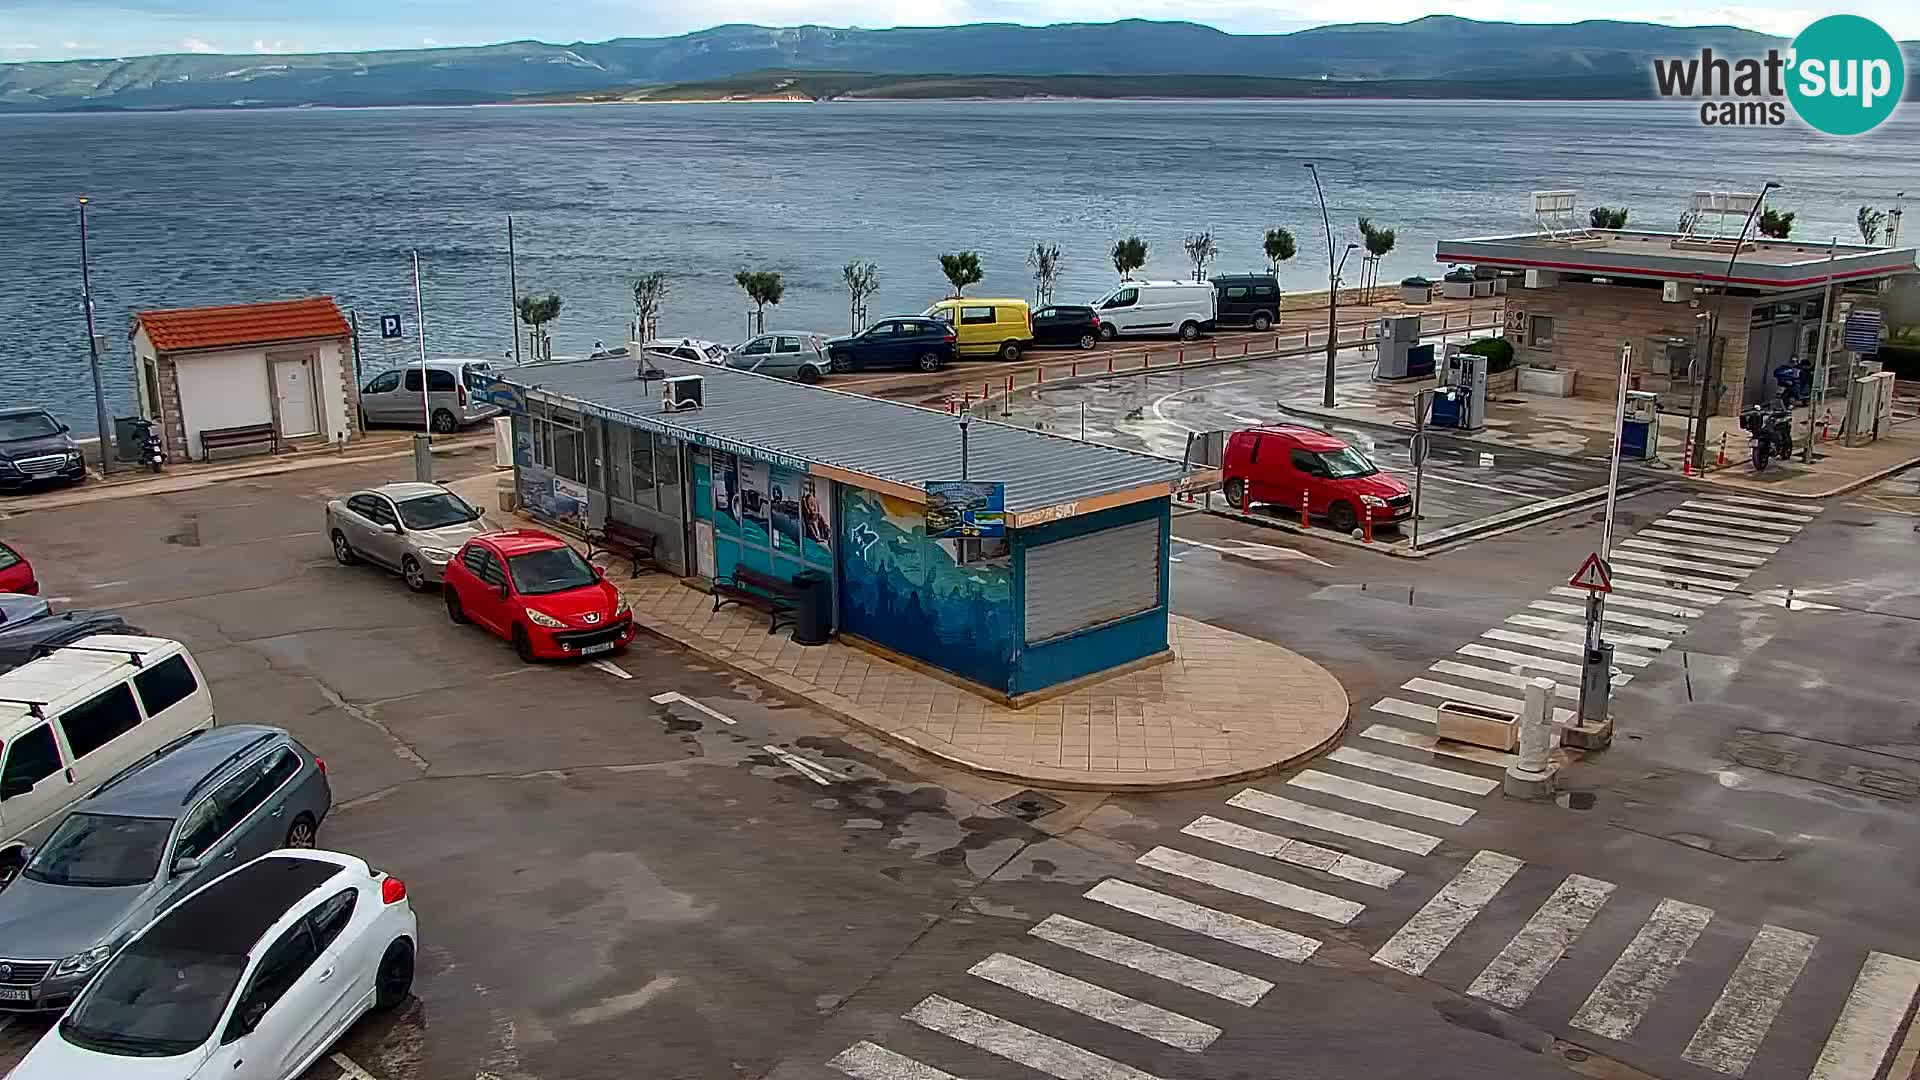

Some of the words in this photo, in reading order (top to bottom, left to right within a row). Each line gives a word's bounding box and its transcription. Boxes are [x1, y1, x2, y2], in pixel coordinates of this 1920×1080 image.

[385, 318, 396, 335] P
[666, 428, 697, 442] POSTAJA
[705, 436, 720, 449] BUS
[722, 442, 752, 457] STATION
[754, 450, 778, 464] TICKET
[779, 455, 806, 471] OFFICE
